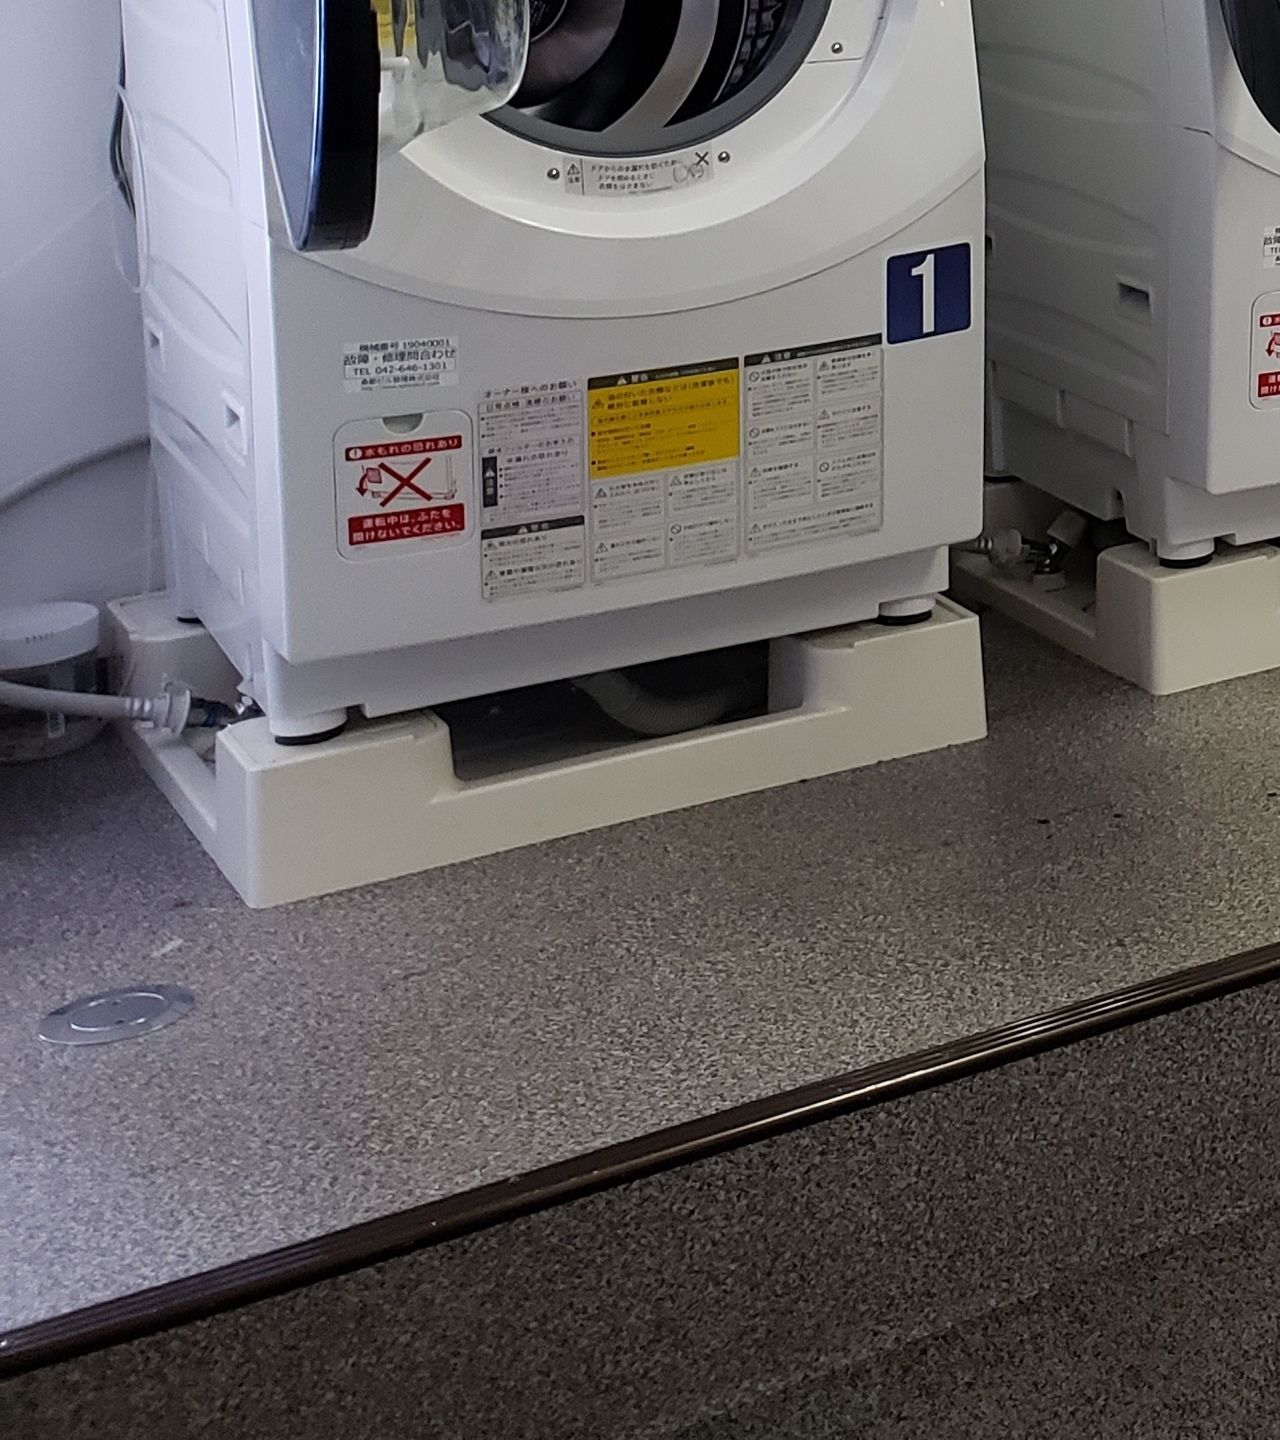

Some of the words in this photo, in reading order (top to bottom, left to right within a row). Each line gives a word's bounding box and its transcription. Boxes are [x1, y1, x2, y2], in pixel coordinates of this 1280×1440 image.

[911, 254, 937, 334] 1
[354, 367, 371, 375] TEL
[375, 362, 446, 375] 042-646-1301
[365, 439, 457, 457] 水もれの恐れあり
[363, 509, 451, 528] 運転中は、ふたを
[353, 521, 460, 542] 開けないでください。
